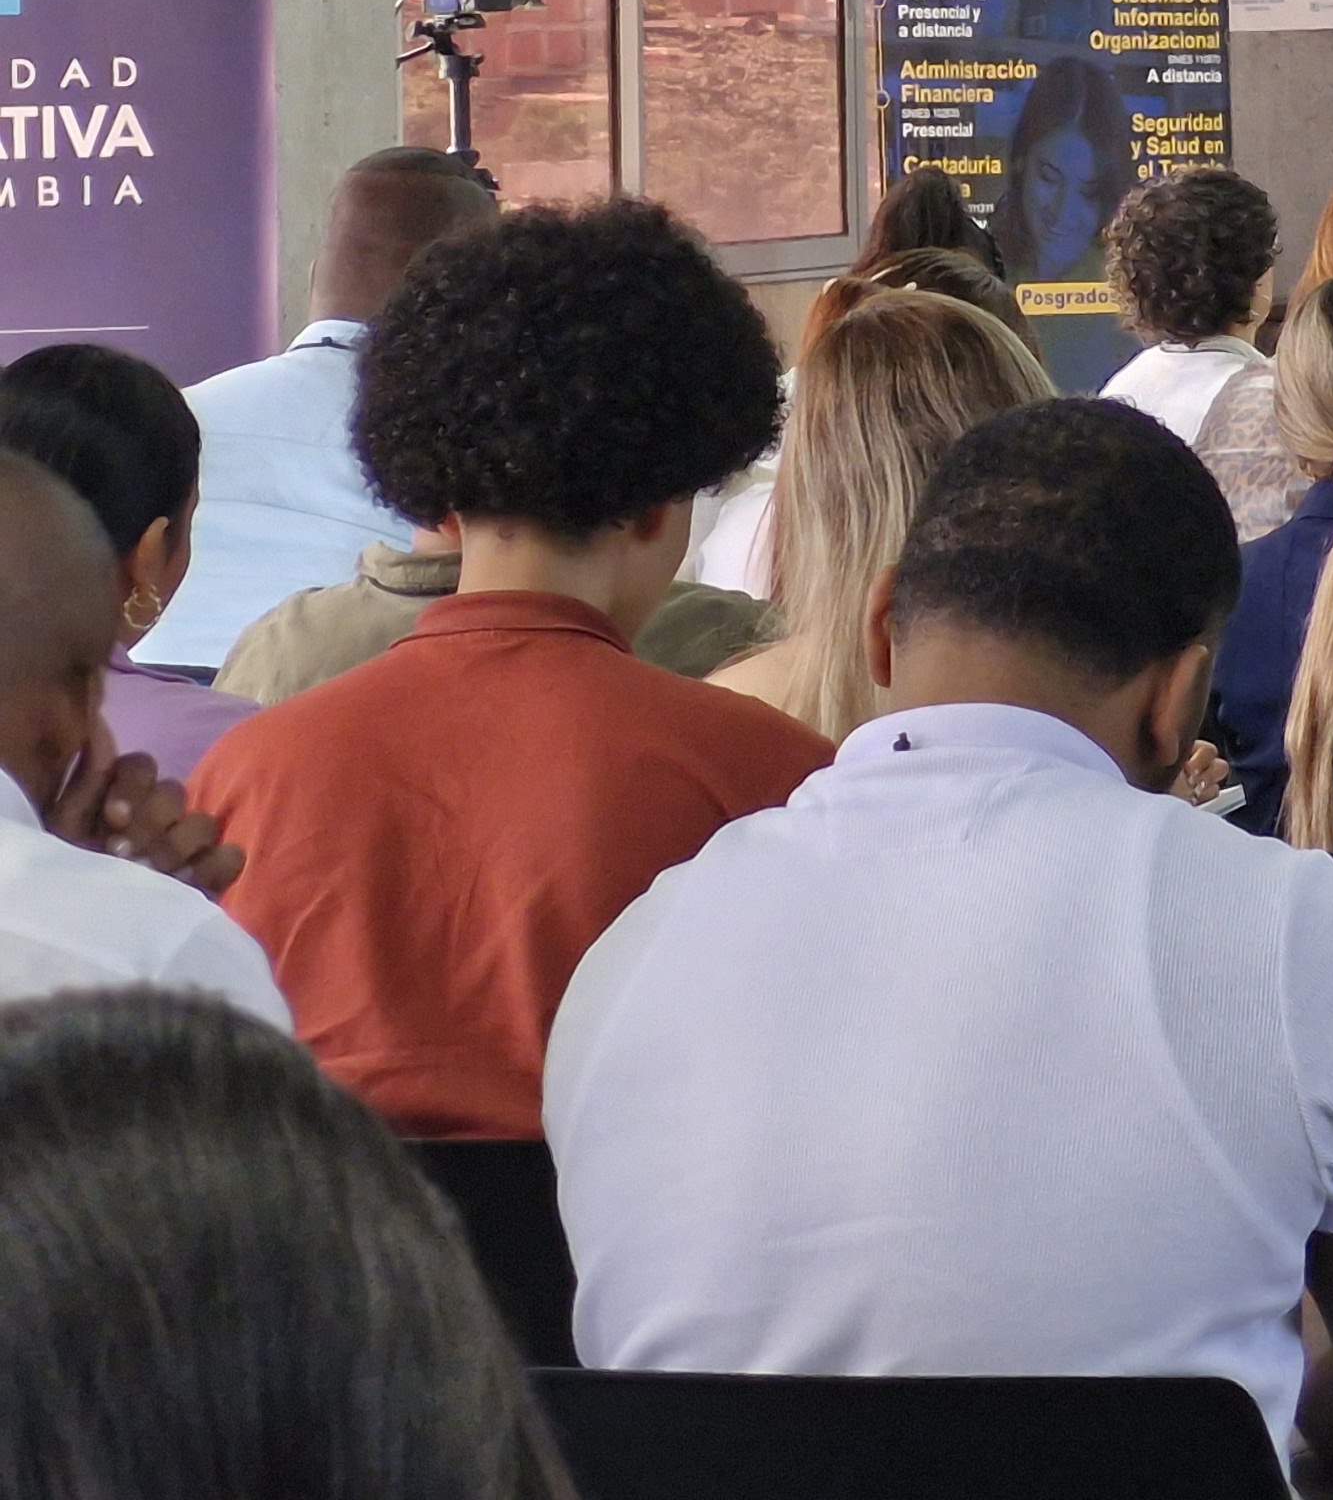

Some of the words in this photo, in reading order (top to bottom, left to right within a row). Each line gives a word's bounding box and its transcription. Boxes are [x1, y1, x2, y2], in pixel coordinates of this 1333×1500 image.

[897, 4, 970, 20] Presencial
[972, 7, 981, 23] y
[1114, 7, 1219, 27] Información
[898, 25, 909, 38] a
[912, 22, 973, 38] distancia
[1090, 29, 1220, 54] Organizacional
[900, 58, 1037, 80] Administración
[1146, 68, 1160, 83] A
[1162, 68, 1223, 83] distancia
[901, 83, 994, 103] Financiera
[0, 104, 155, 160] TIVA
[902, 121, 973, 138] Presencial
[1131, 112, 1224, 137] Seguridad
[1130, 140, 1142, 160] y
[1146, 135, 1200, 155] Salud
[1203, 140, 1224, 154] en
[1137, 160, 1154, 179] el
